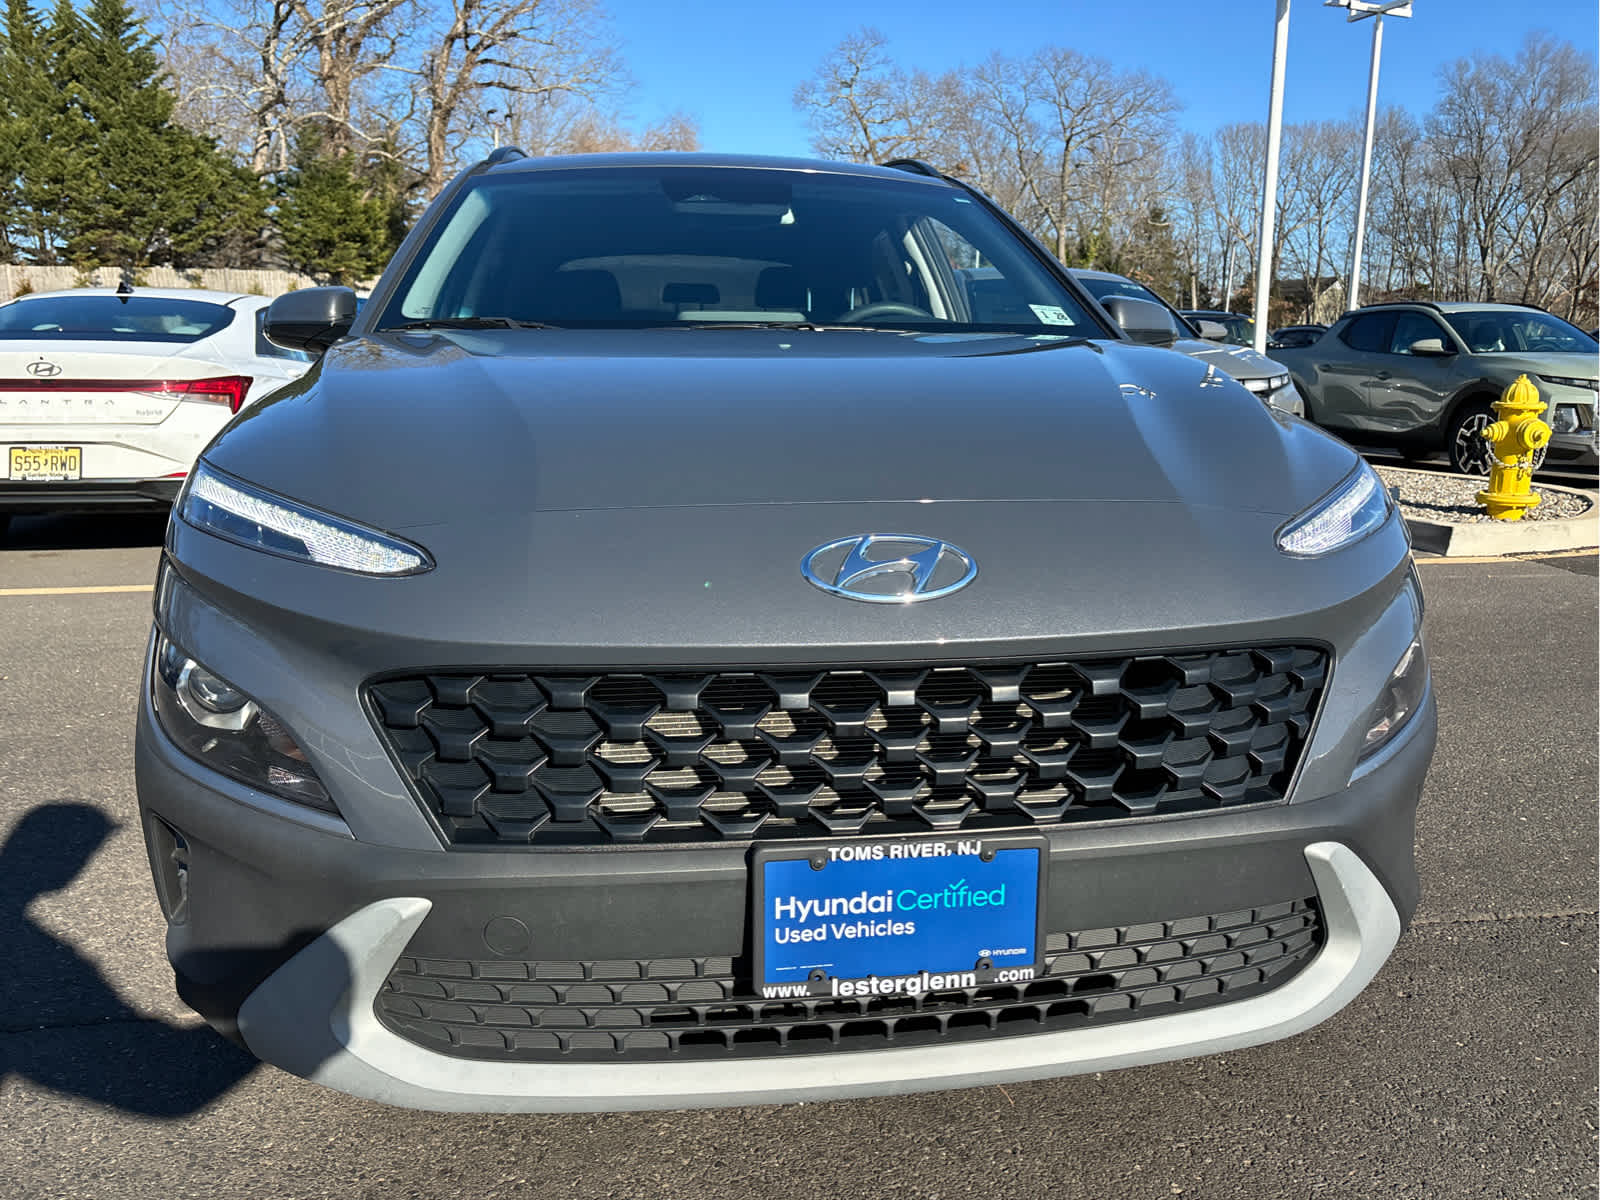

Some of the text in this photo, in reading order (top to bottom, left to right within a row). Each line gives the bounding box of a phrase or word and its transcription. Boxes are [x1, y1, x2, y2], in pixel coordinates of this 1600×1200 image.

[15, 455, 77, 471] S55 RWD
[828, 840, 982, 862] TOMS RIVER, NJ
[774, 878, 1006, 923] Hyundai Certified
[775, 919, 916, 944] Used Vehicles
[762, 967, 1035, 999] www. lesterglenn .com
